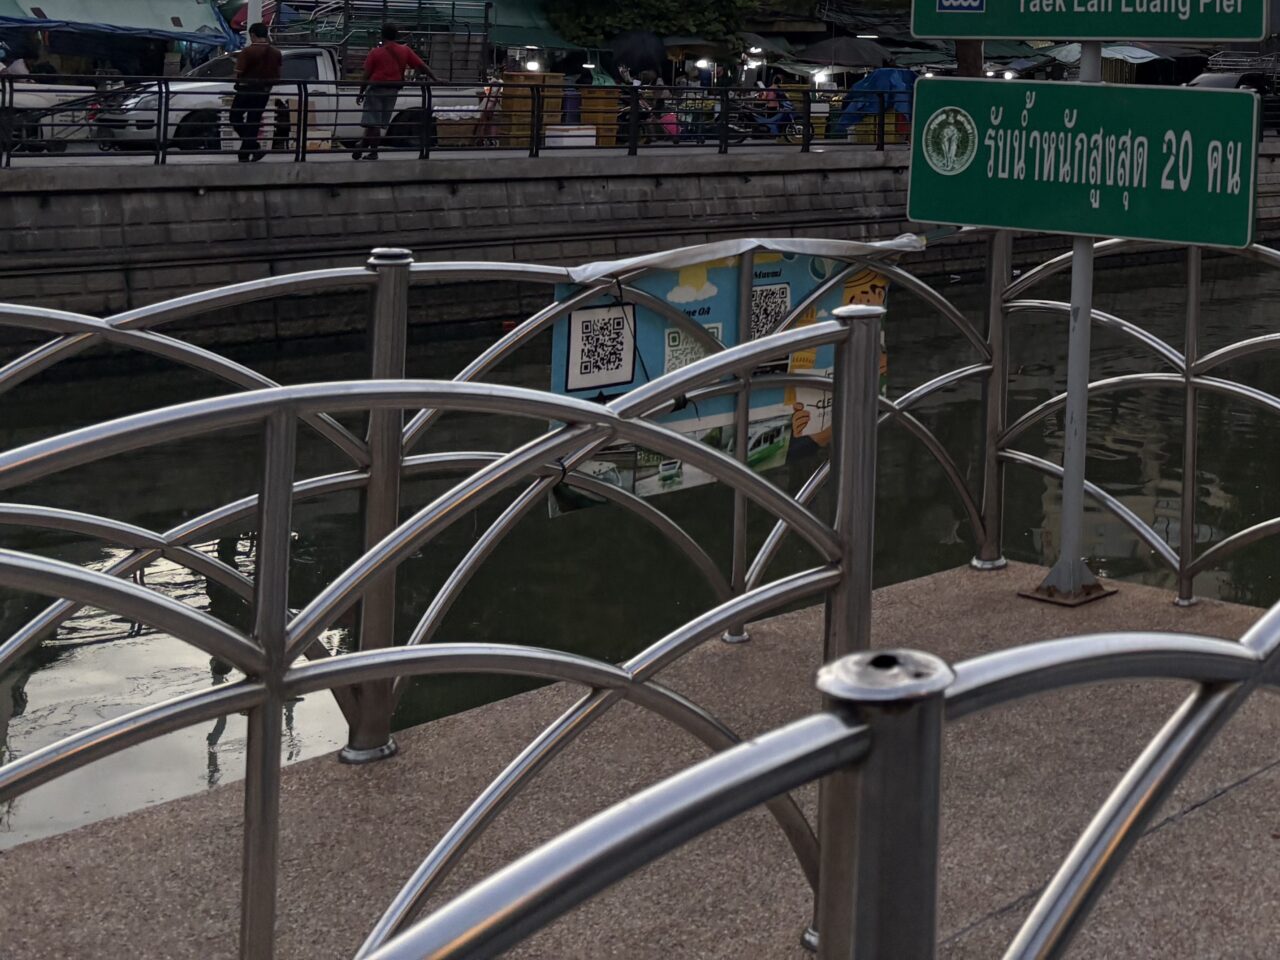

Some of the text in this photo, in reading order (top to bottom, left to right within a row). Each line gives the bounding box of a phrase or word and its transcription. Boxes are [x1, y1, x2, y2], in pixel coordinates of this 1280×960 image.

[983, 90, 1243, 211] รับน้ำหนักสูงสุด 20 คน
